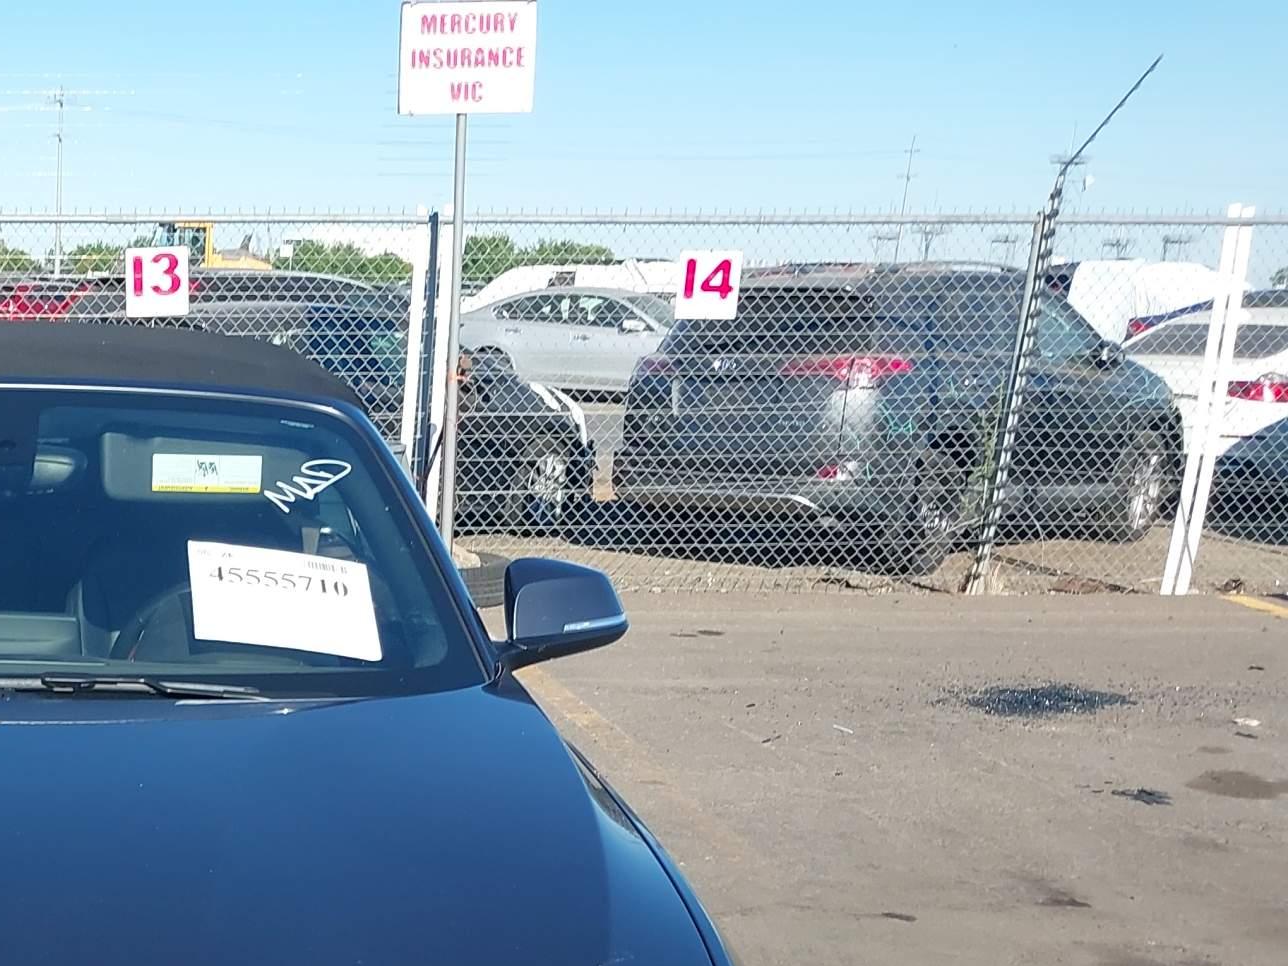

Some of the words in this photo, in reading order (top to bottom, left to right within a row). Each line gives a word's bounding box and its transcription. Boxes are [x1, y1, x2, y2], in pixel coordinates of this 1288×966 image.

[420, 12, 519, 35] MERCURY
[411, 46, 526, 69] INSURANCE
[450, 81, 484, 102] VIC
[133, 253, 181, 297] 13
[684, 258, 733, 299] 14
[209, 566, 349, 597] 45555710
